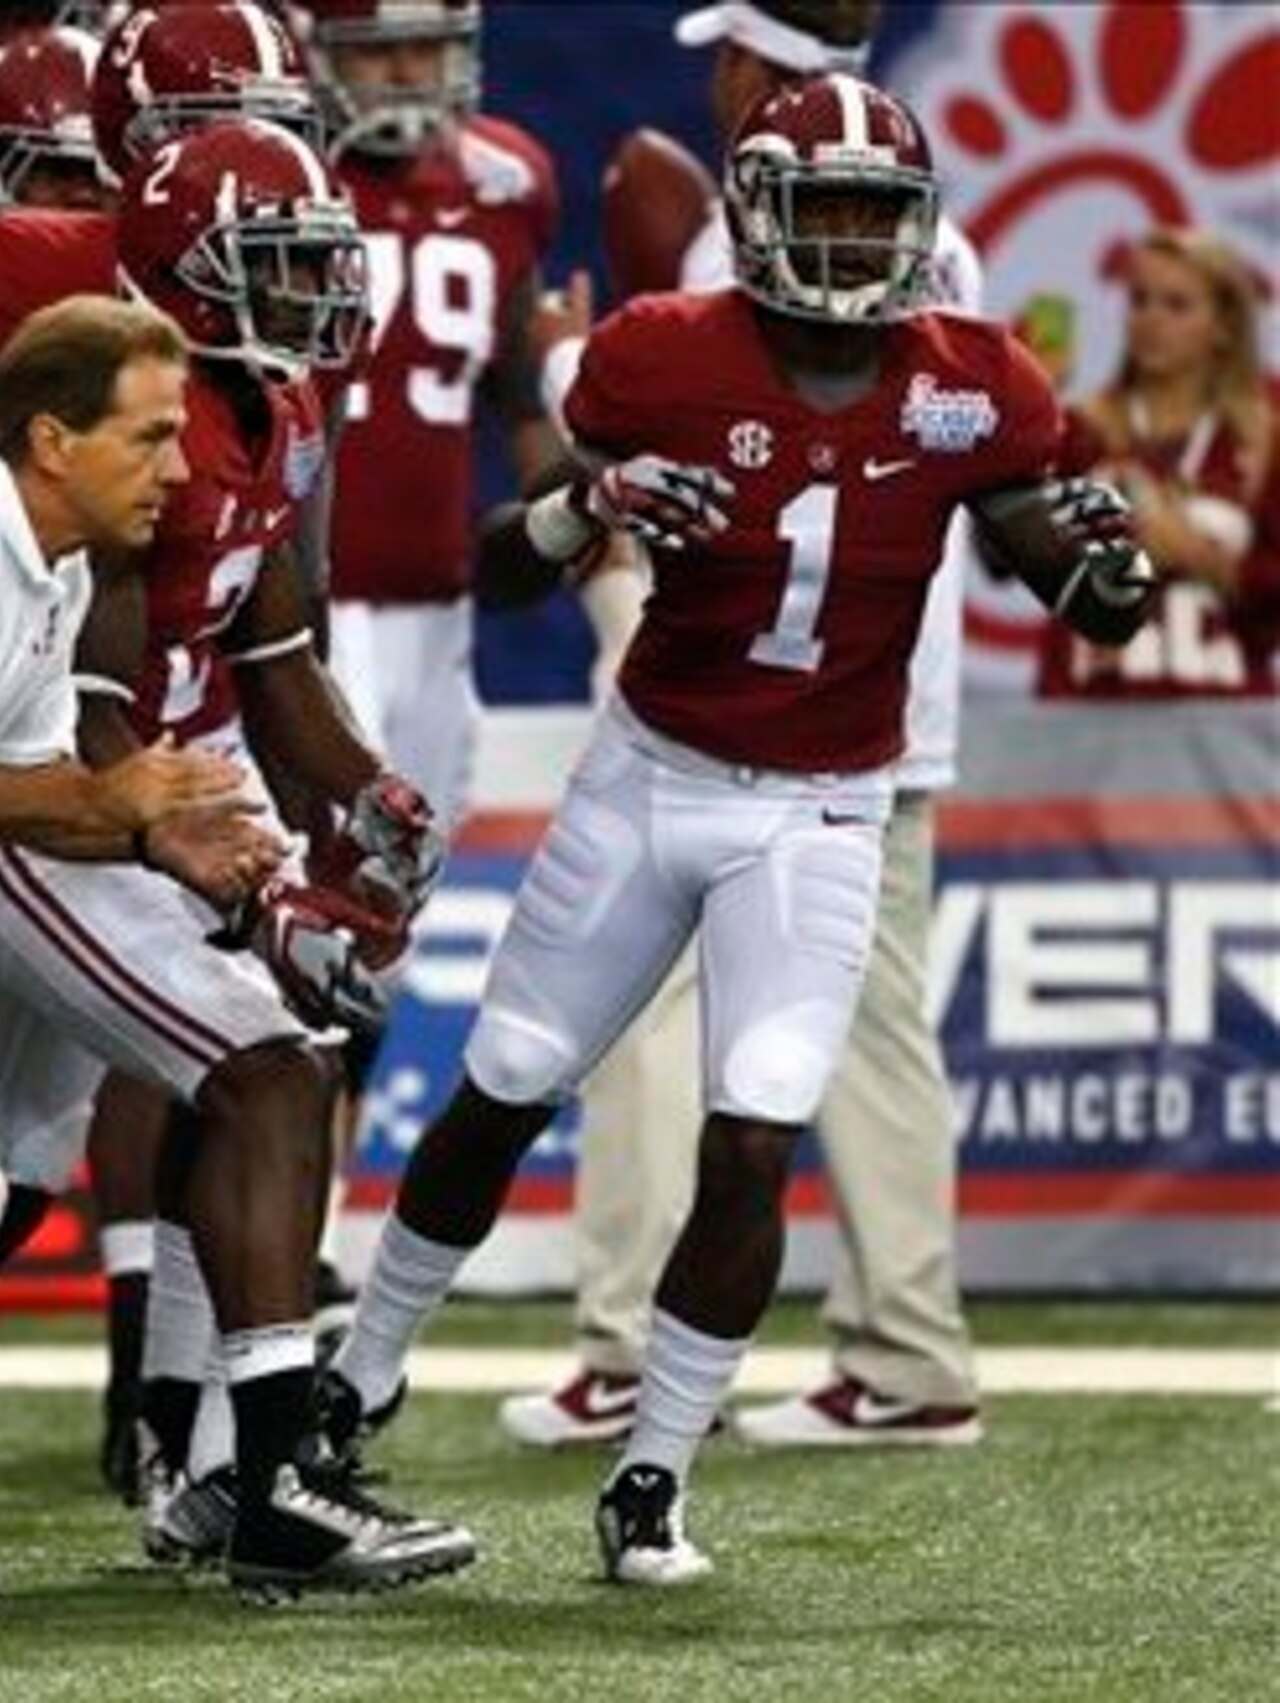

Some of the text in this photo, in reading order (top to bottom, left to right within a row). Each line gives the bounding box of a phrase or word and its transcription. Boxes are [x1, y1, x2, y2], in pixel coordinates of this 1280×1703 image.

[143, 143, 183, 206] 2
[346, 232, 496, 423] 79
[748, 482, 839, 671] 1
